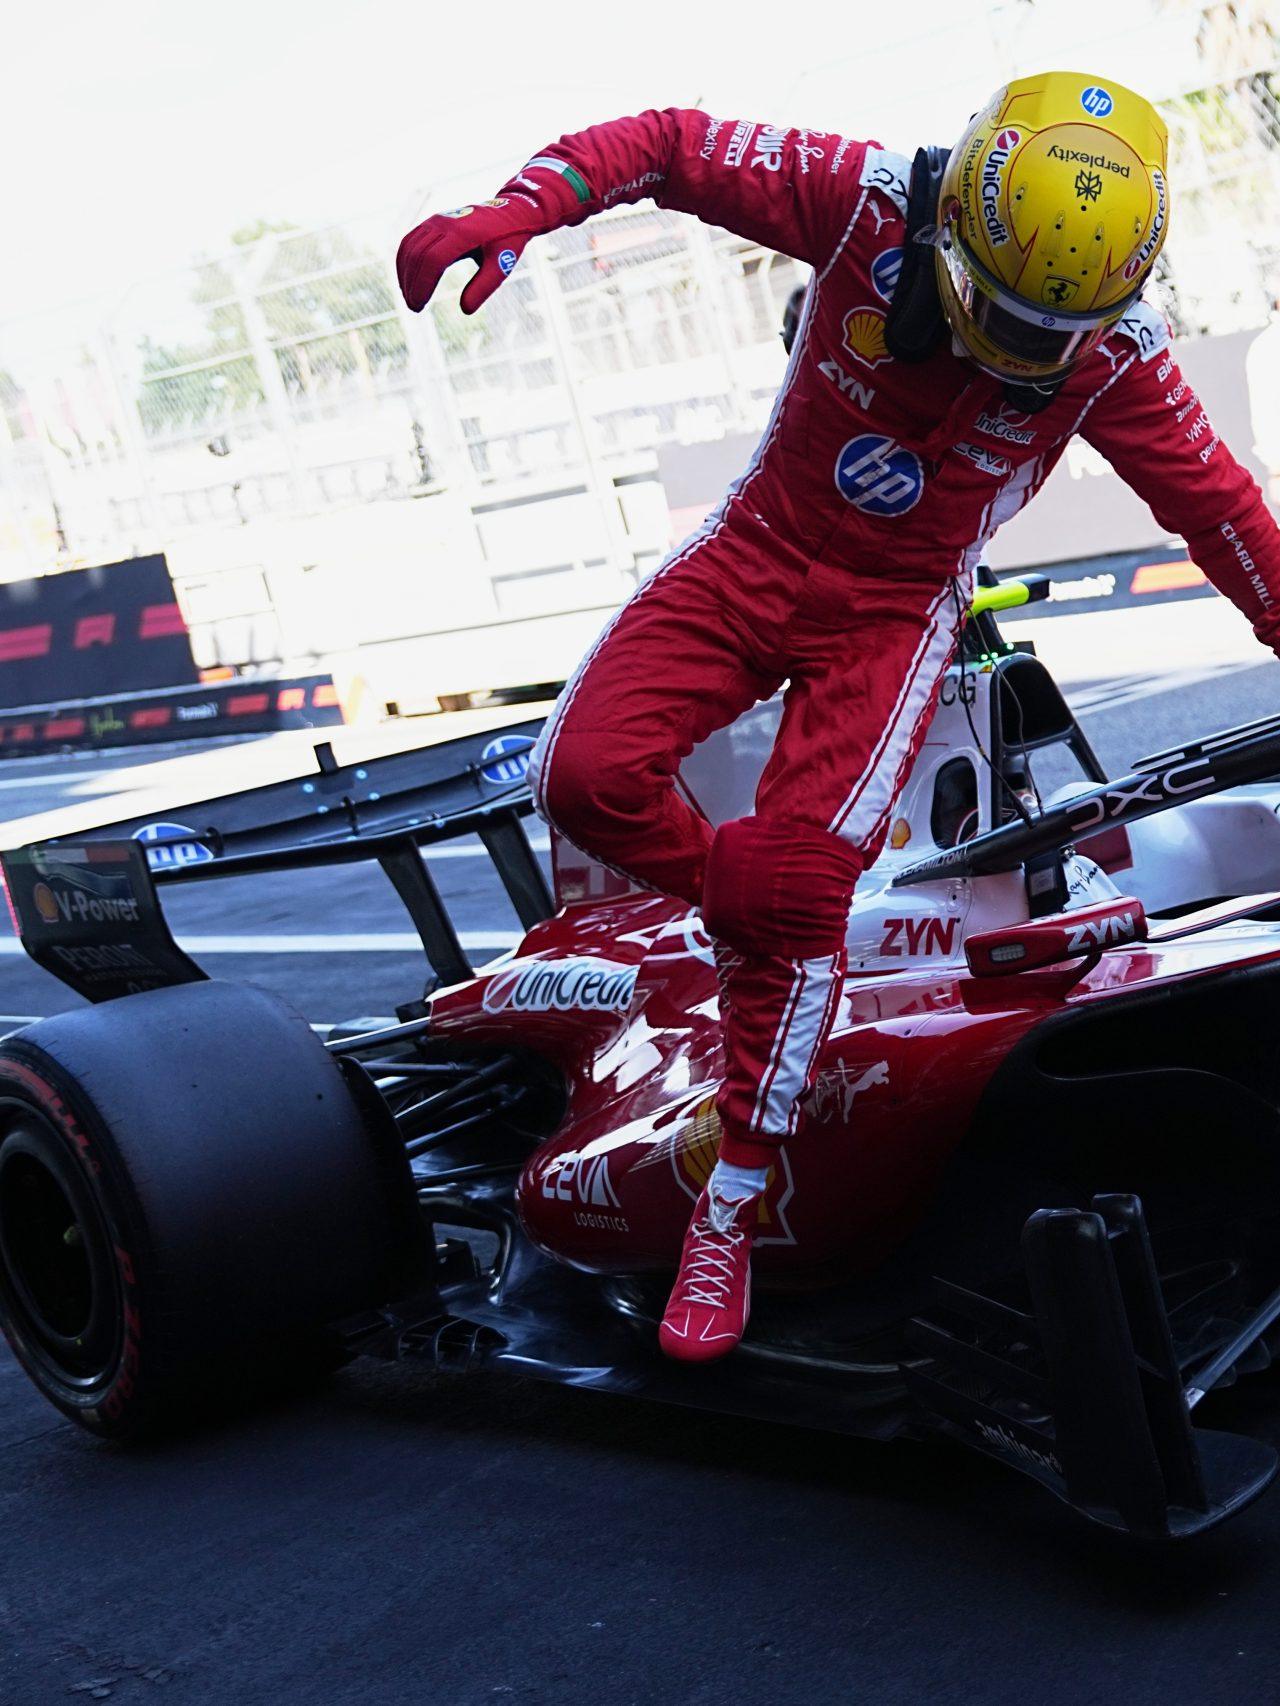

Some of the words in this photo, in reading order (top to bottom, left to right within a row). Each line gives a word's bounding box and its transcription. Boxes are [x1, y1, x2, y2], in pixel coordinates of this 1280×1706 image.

[1083, 86, 1112, 117] hp
[1047, 145, 1131, 179] perplexity
[962, 138, 984, 240] Bitdefender
[982, 150, 1009, 246] UniCredit
[1138, 171, 1166, 262] UniCredit
[817, 361, 875, 410] ZYN
[840, 435, 918, 509] hp
[55, 887, 141, 923] V-Power
[879, 917, 956, 957] ZYN
[1065, 912, 1135, 952] ZYN
[573, 1211, 630, 1233] LOGISTICS
